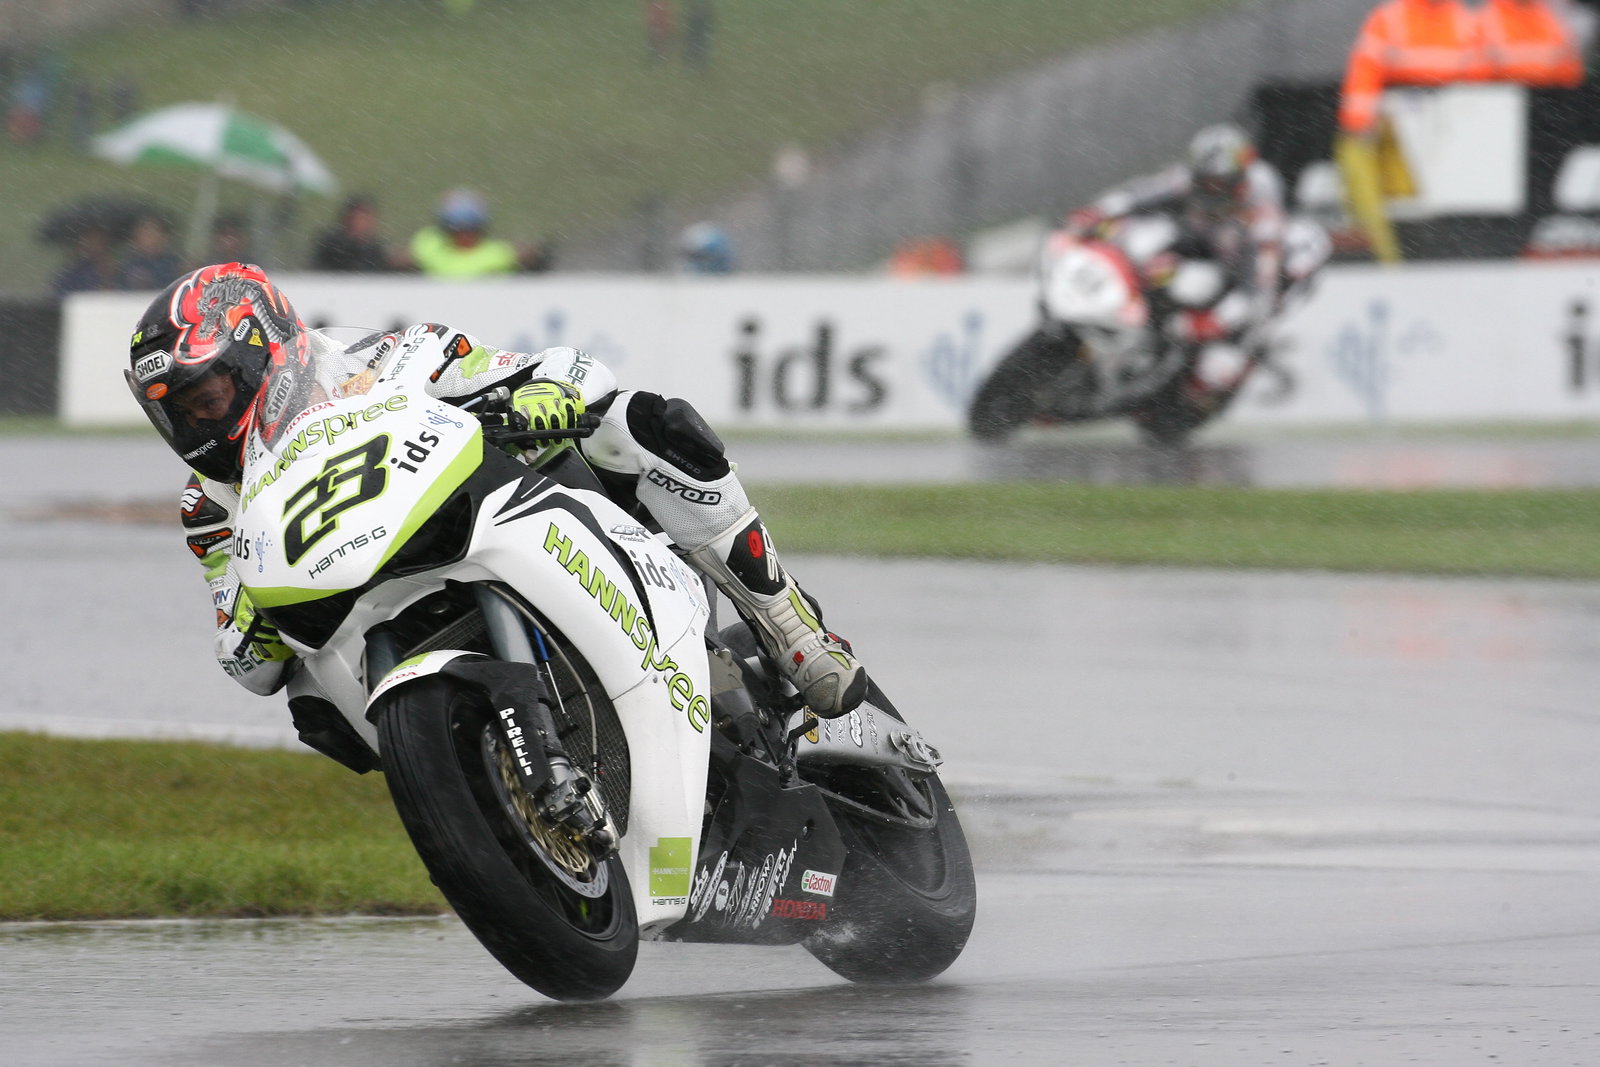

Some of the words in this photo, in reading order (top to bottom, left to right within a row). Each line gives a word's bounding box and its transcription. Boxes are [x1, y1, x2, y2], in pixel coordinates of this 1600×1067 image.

[137, 354, 165, 378] SHOEI
[367, 341, 391, 369] Puig
[731, 314, 891, 414] ids
[267, 375, 292, 418] SHOEI
[285, 402, 335, 435] HONDA
[390, 430, 440, 474] ids
[280, 432, 393, 567] 23
[647, 468, 722, 506] HYOD
[232, 526, 250, 560] ids
[610, 523, 651, 540] CBR
[629, 549, 676, 591] ids
[499, 707, 533, 776] PIRELLI
[809, 874, 833, 893] Castrol
[771, 899, 827, 920] HONDA
